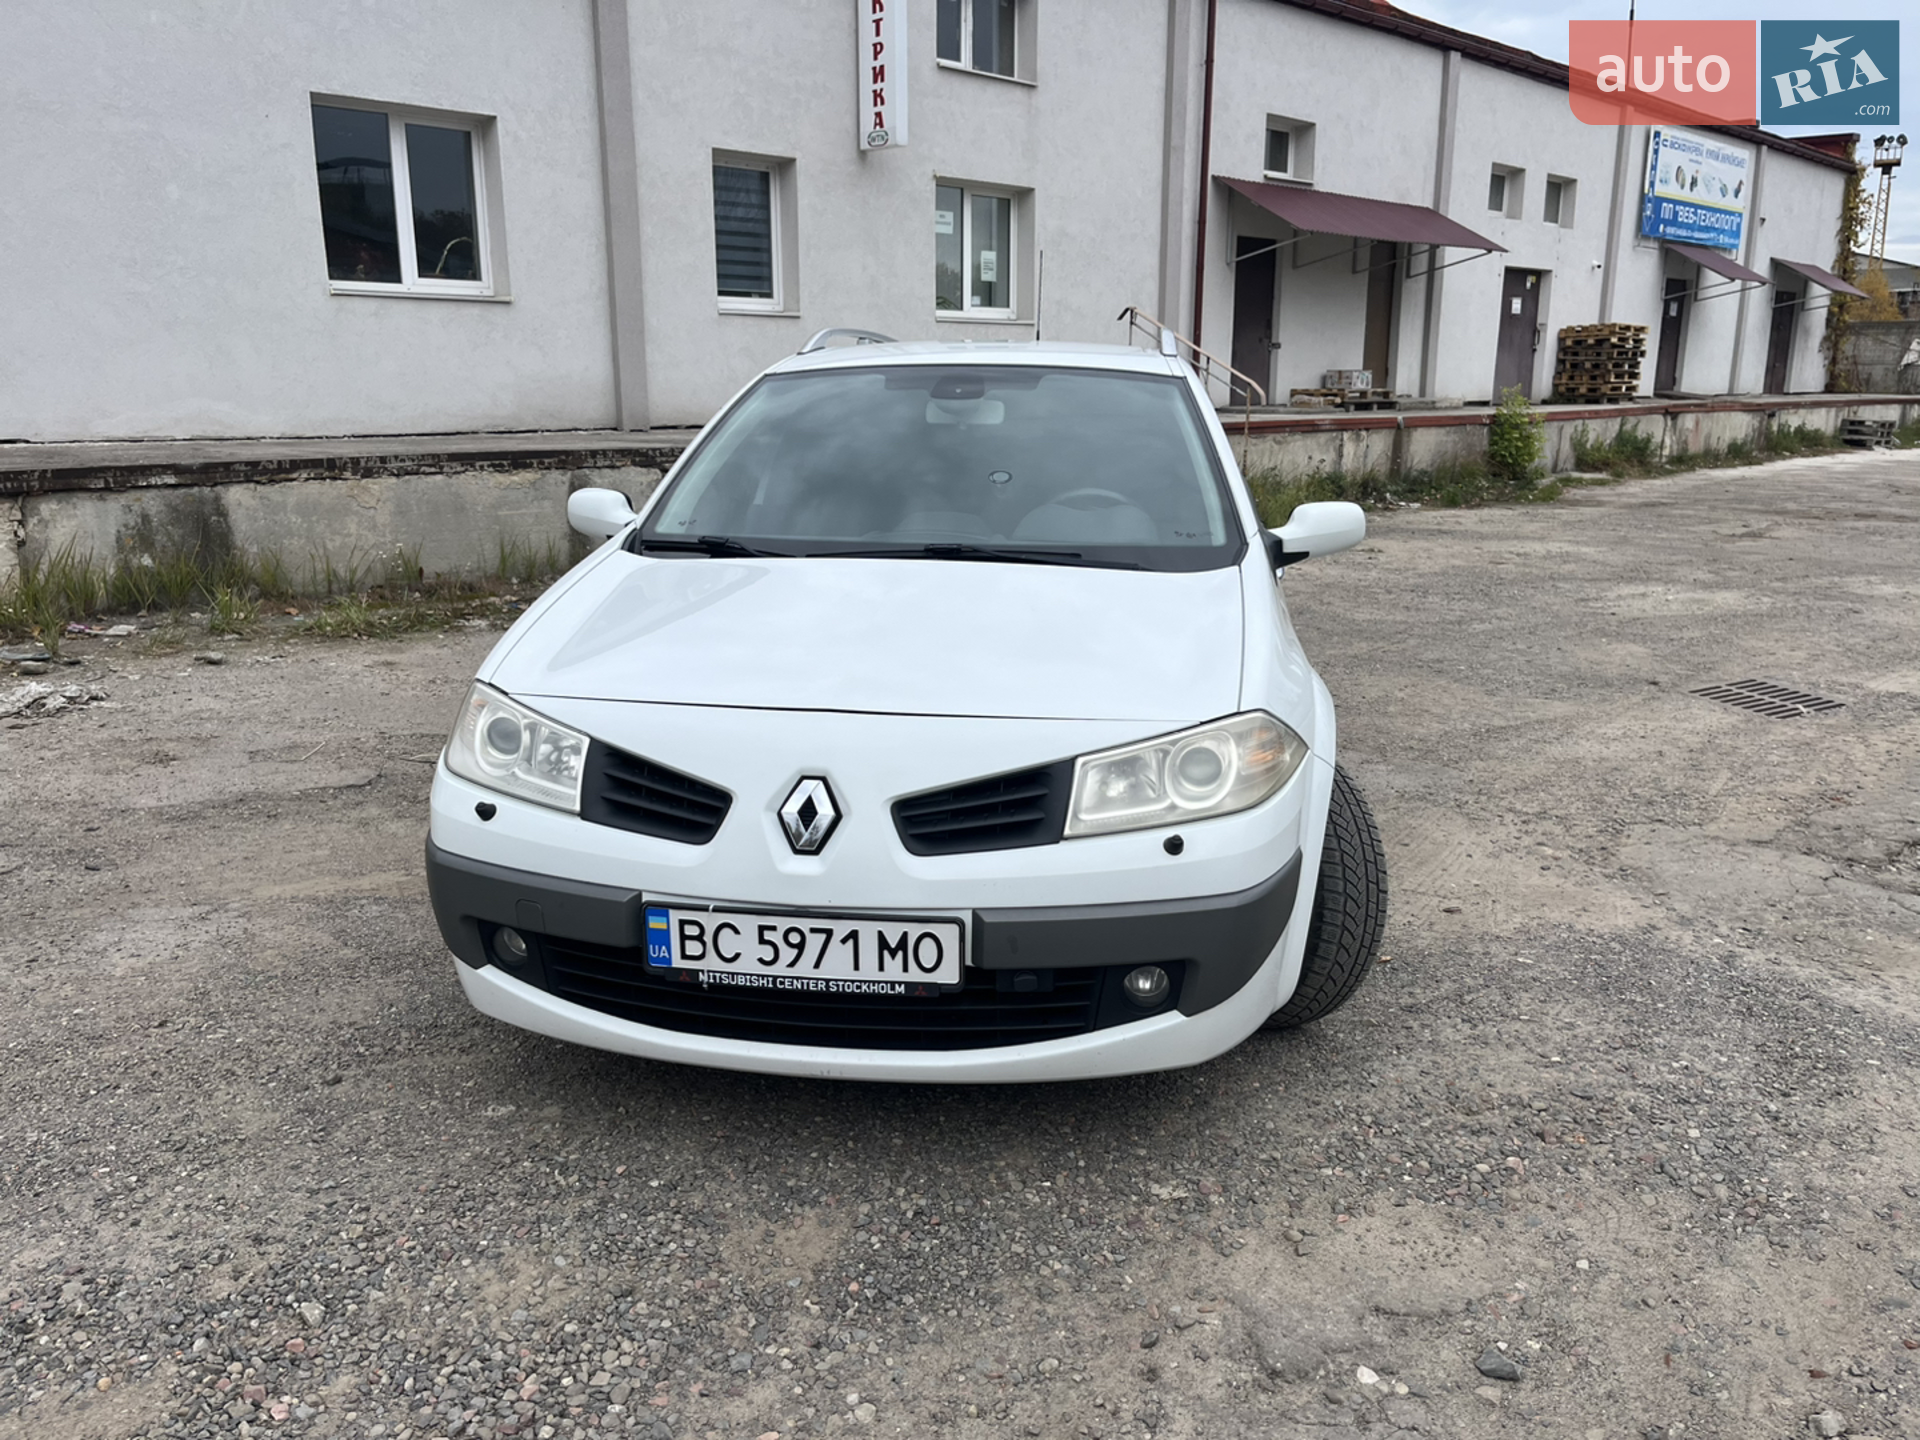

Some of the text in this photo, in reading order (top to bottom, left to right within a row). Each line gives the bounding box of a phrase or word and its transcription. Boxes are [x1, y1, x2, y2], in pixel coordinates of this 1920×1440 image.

[1660, 202, 1674, 220] ПП
[649, 944, 670, 959] UA
[678, 918, 944, 974] BC 5971 MO
[776, 977, 827, 992] CENTER
[829, 981, 905, 996] STOCKHOLM
